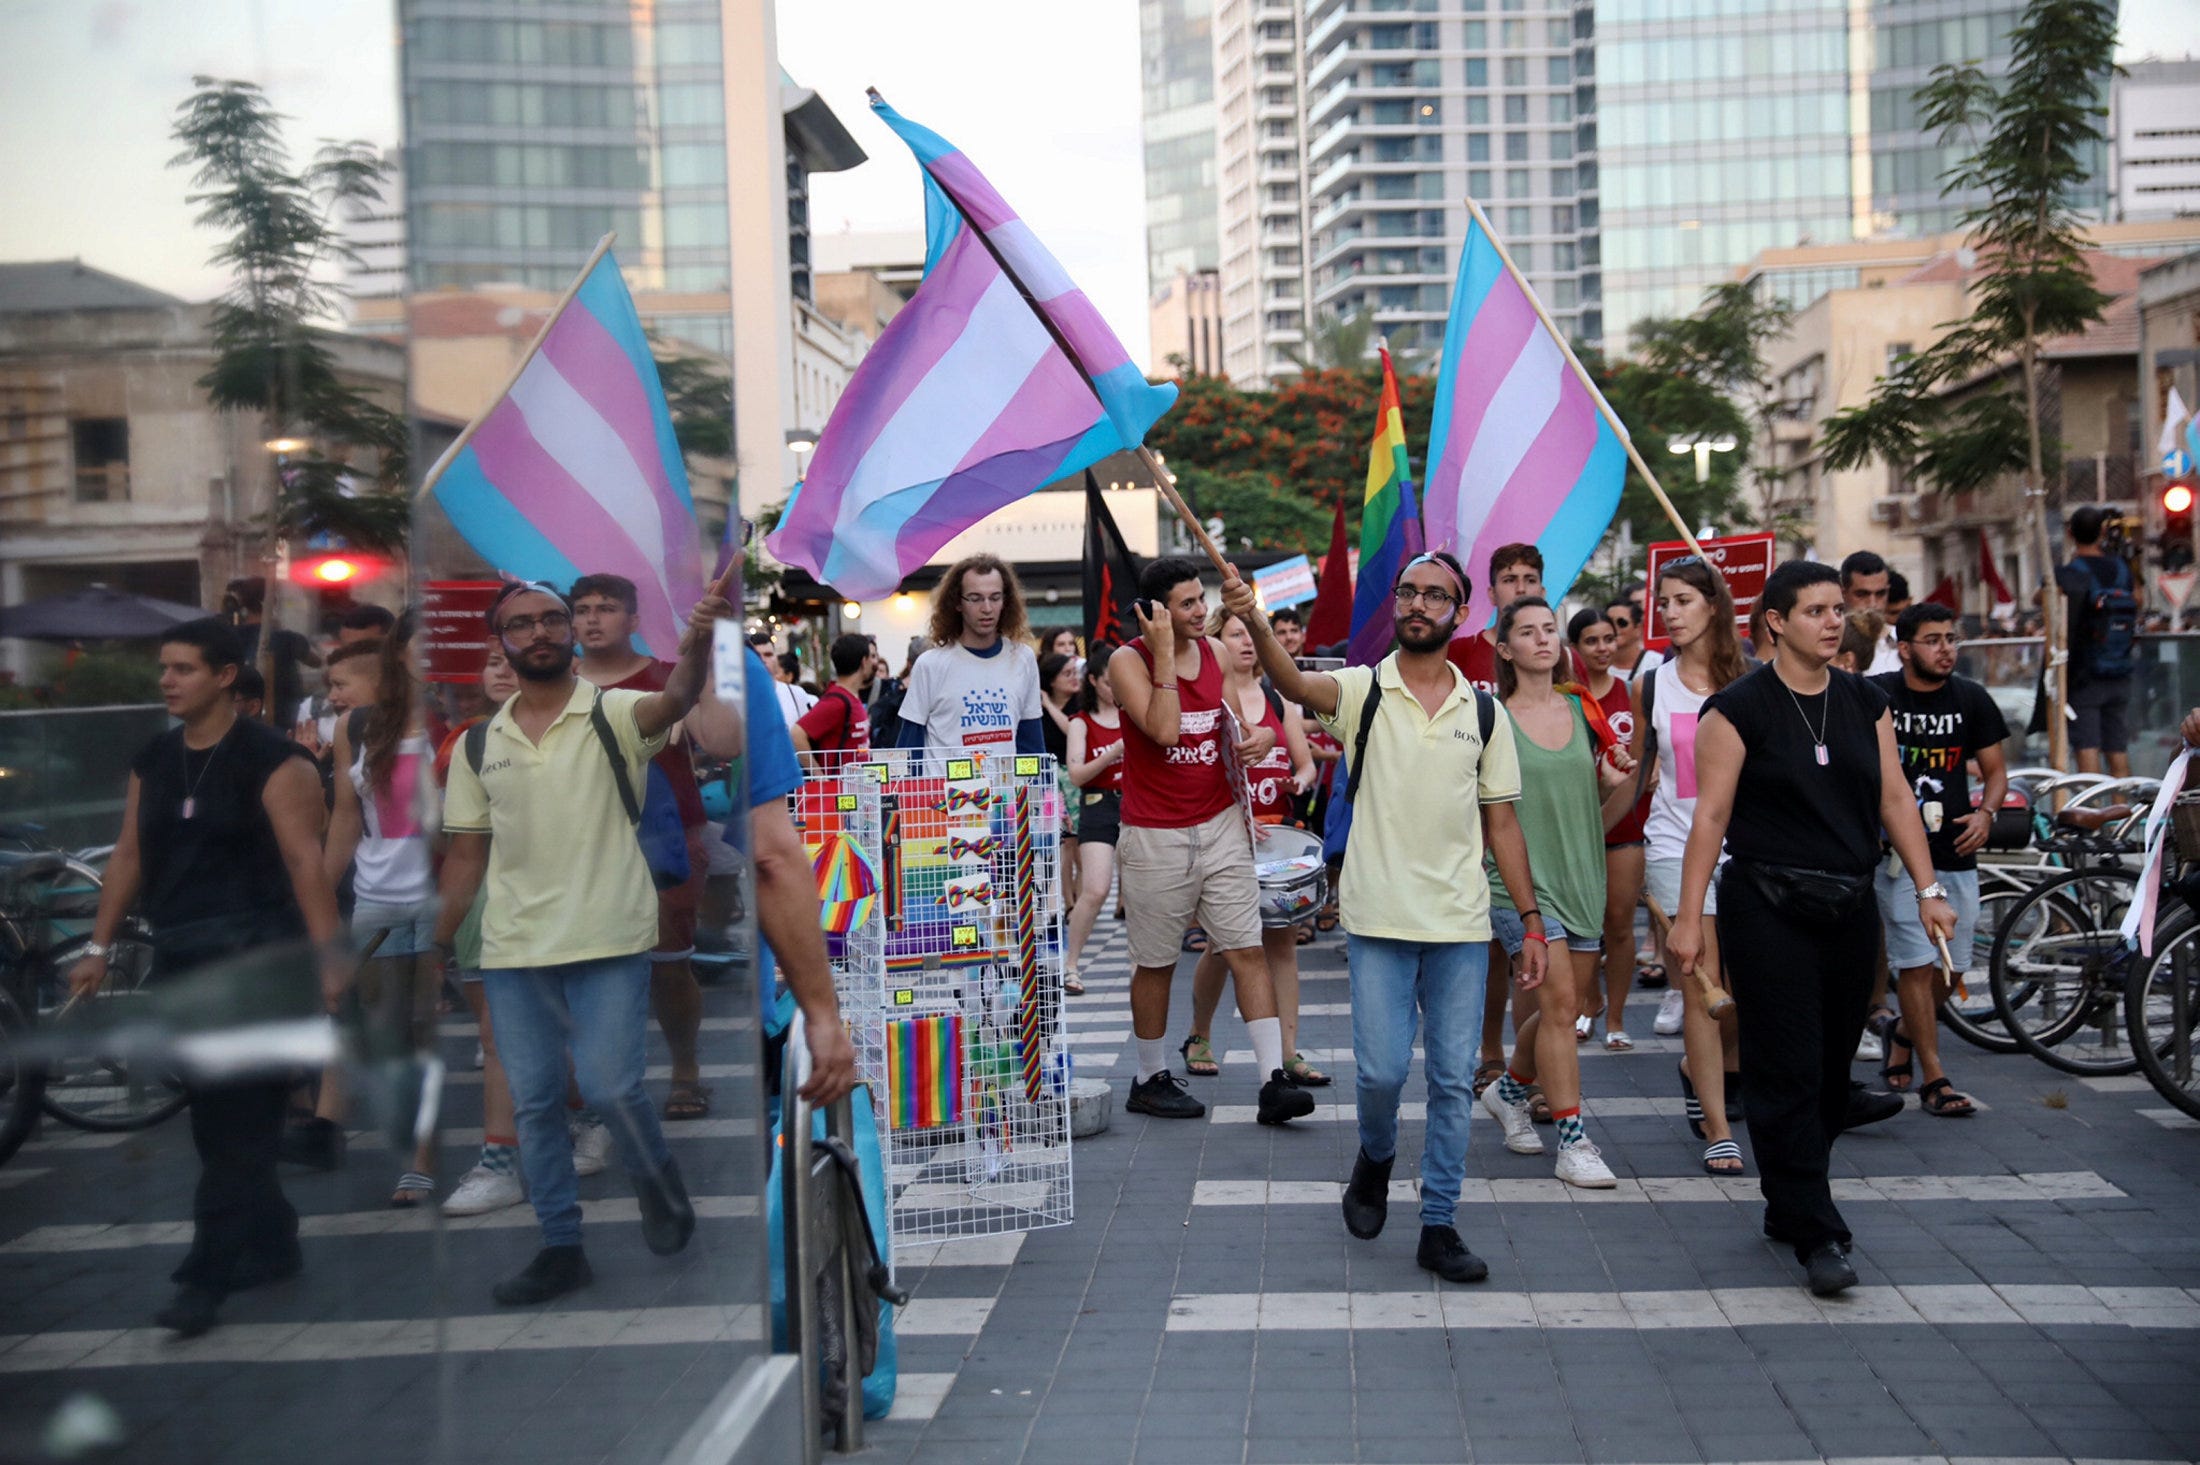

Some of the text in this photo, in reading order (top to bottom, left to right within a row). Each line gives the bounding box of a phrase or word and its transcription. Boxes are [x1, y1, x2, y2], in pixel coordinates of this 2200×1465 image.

[964, 701, 1008, 714] ישראל
[961, 714, 1012, 727] חופשית
[1166, 746, 1199, 761] איגי
